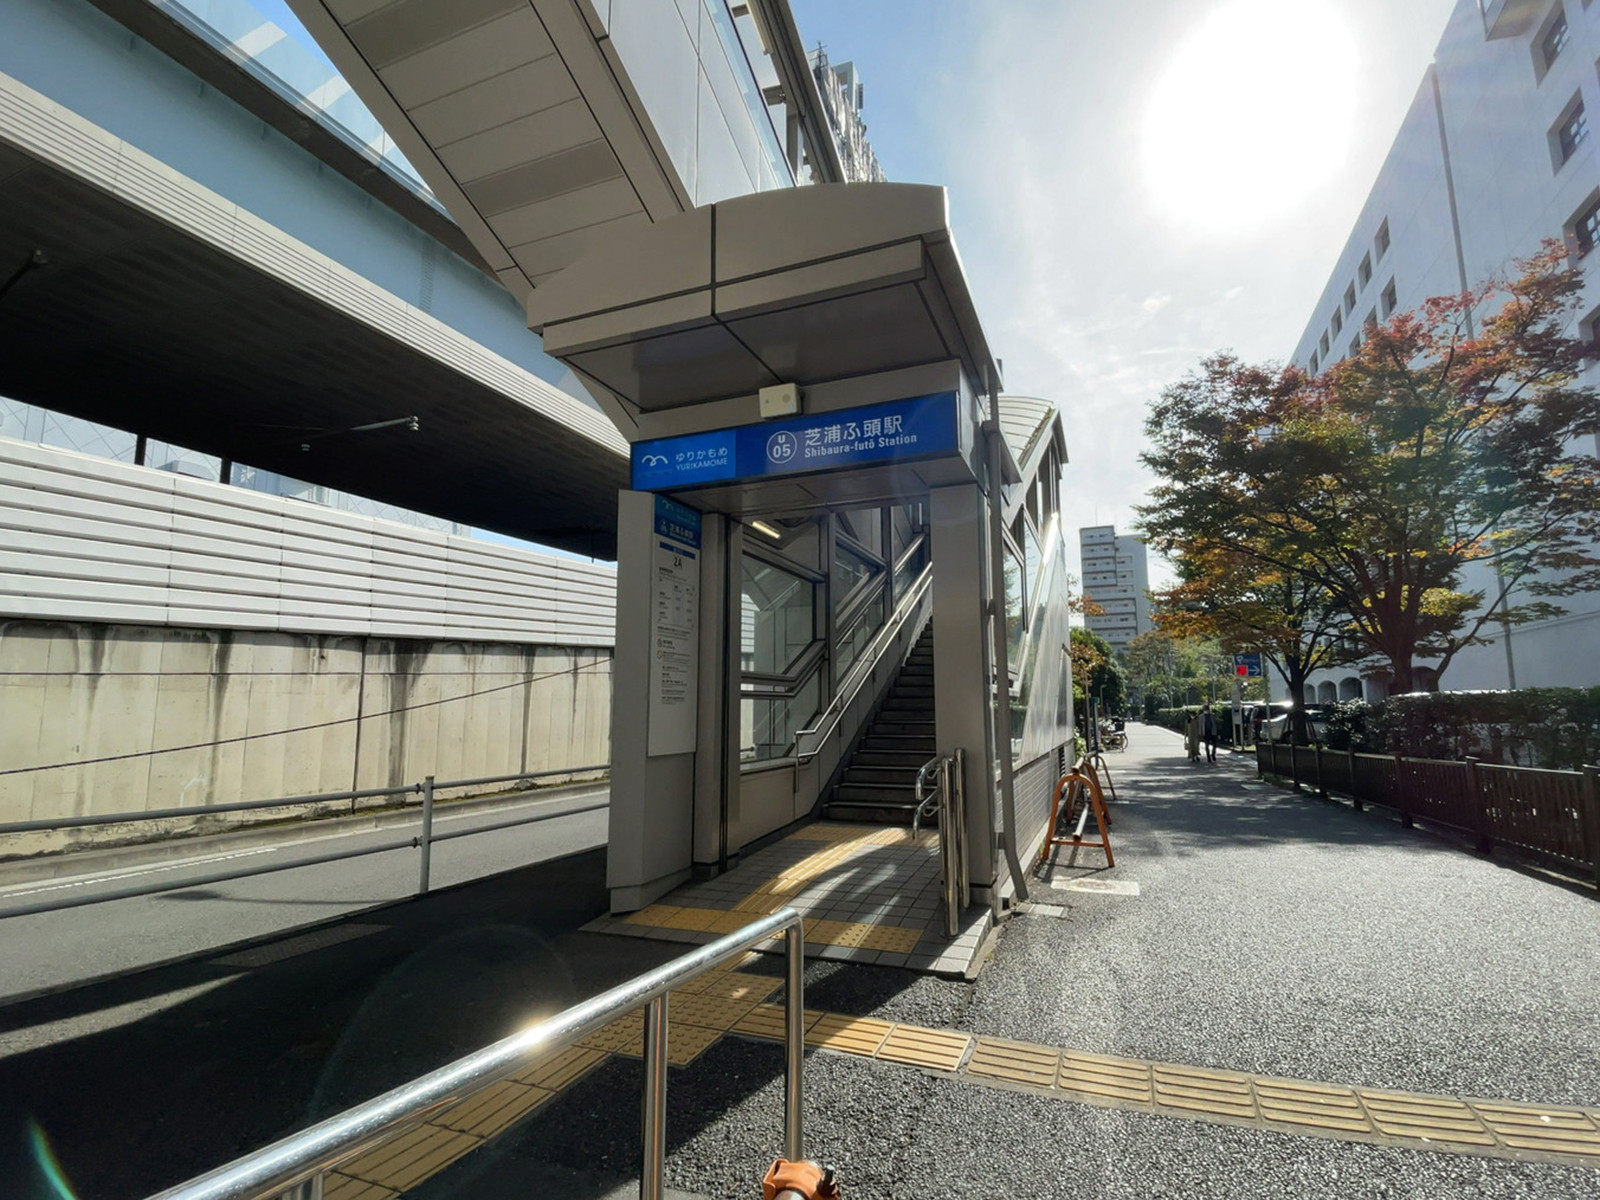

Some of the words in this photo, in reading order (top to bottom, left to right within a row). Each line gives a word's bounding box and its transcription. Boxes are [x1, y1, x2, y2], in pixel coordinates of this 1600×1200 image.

[804, 415, 902, 447] 芝浦ふ頭駅
[777, 435, 786, 443] U
[878, 434, 917, 448] Station
[675, 447, 728, 462] ゆりかもめ
[772, 444, 791, 458] 05
[676, 458, 728, 471] YURIKAMOME
